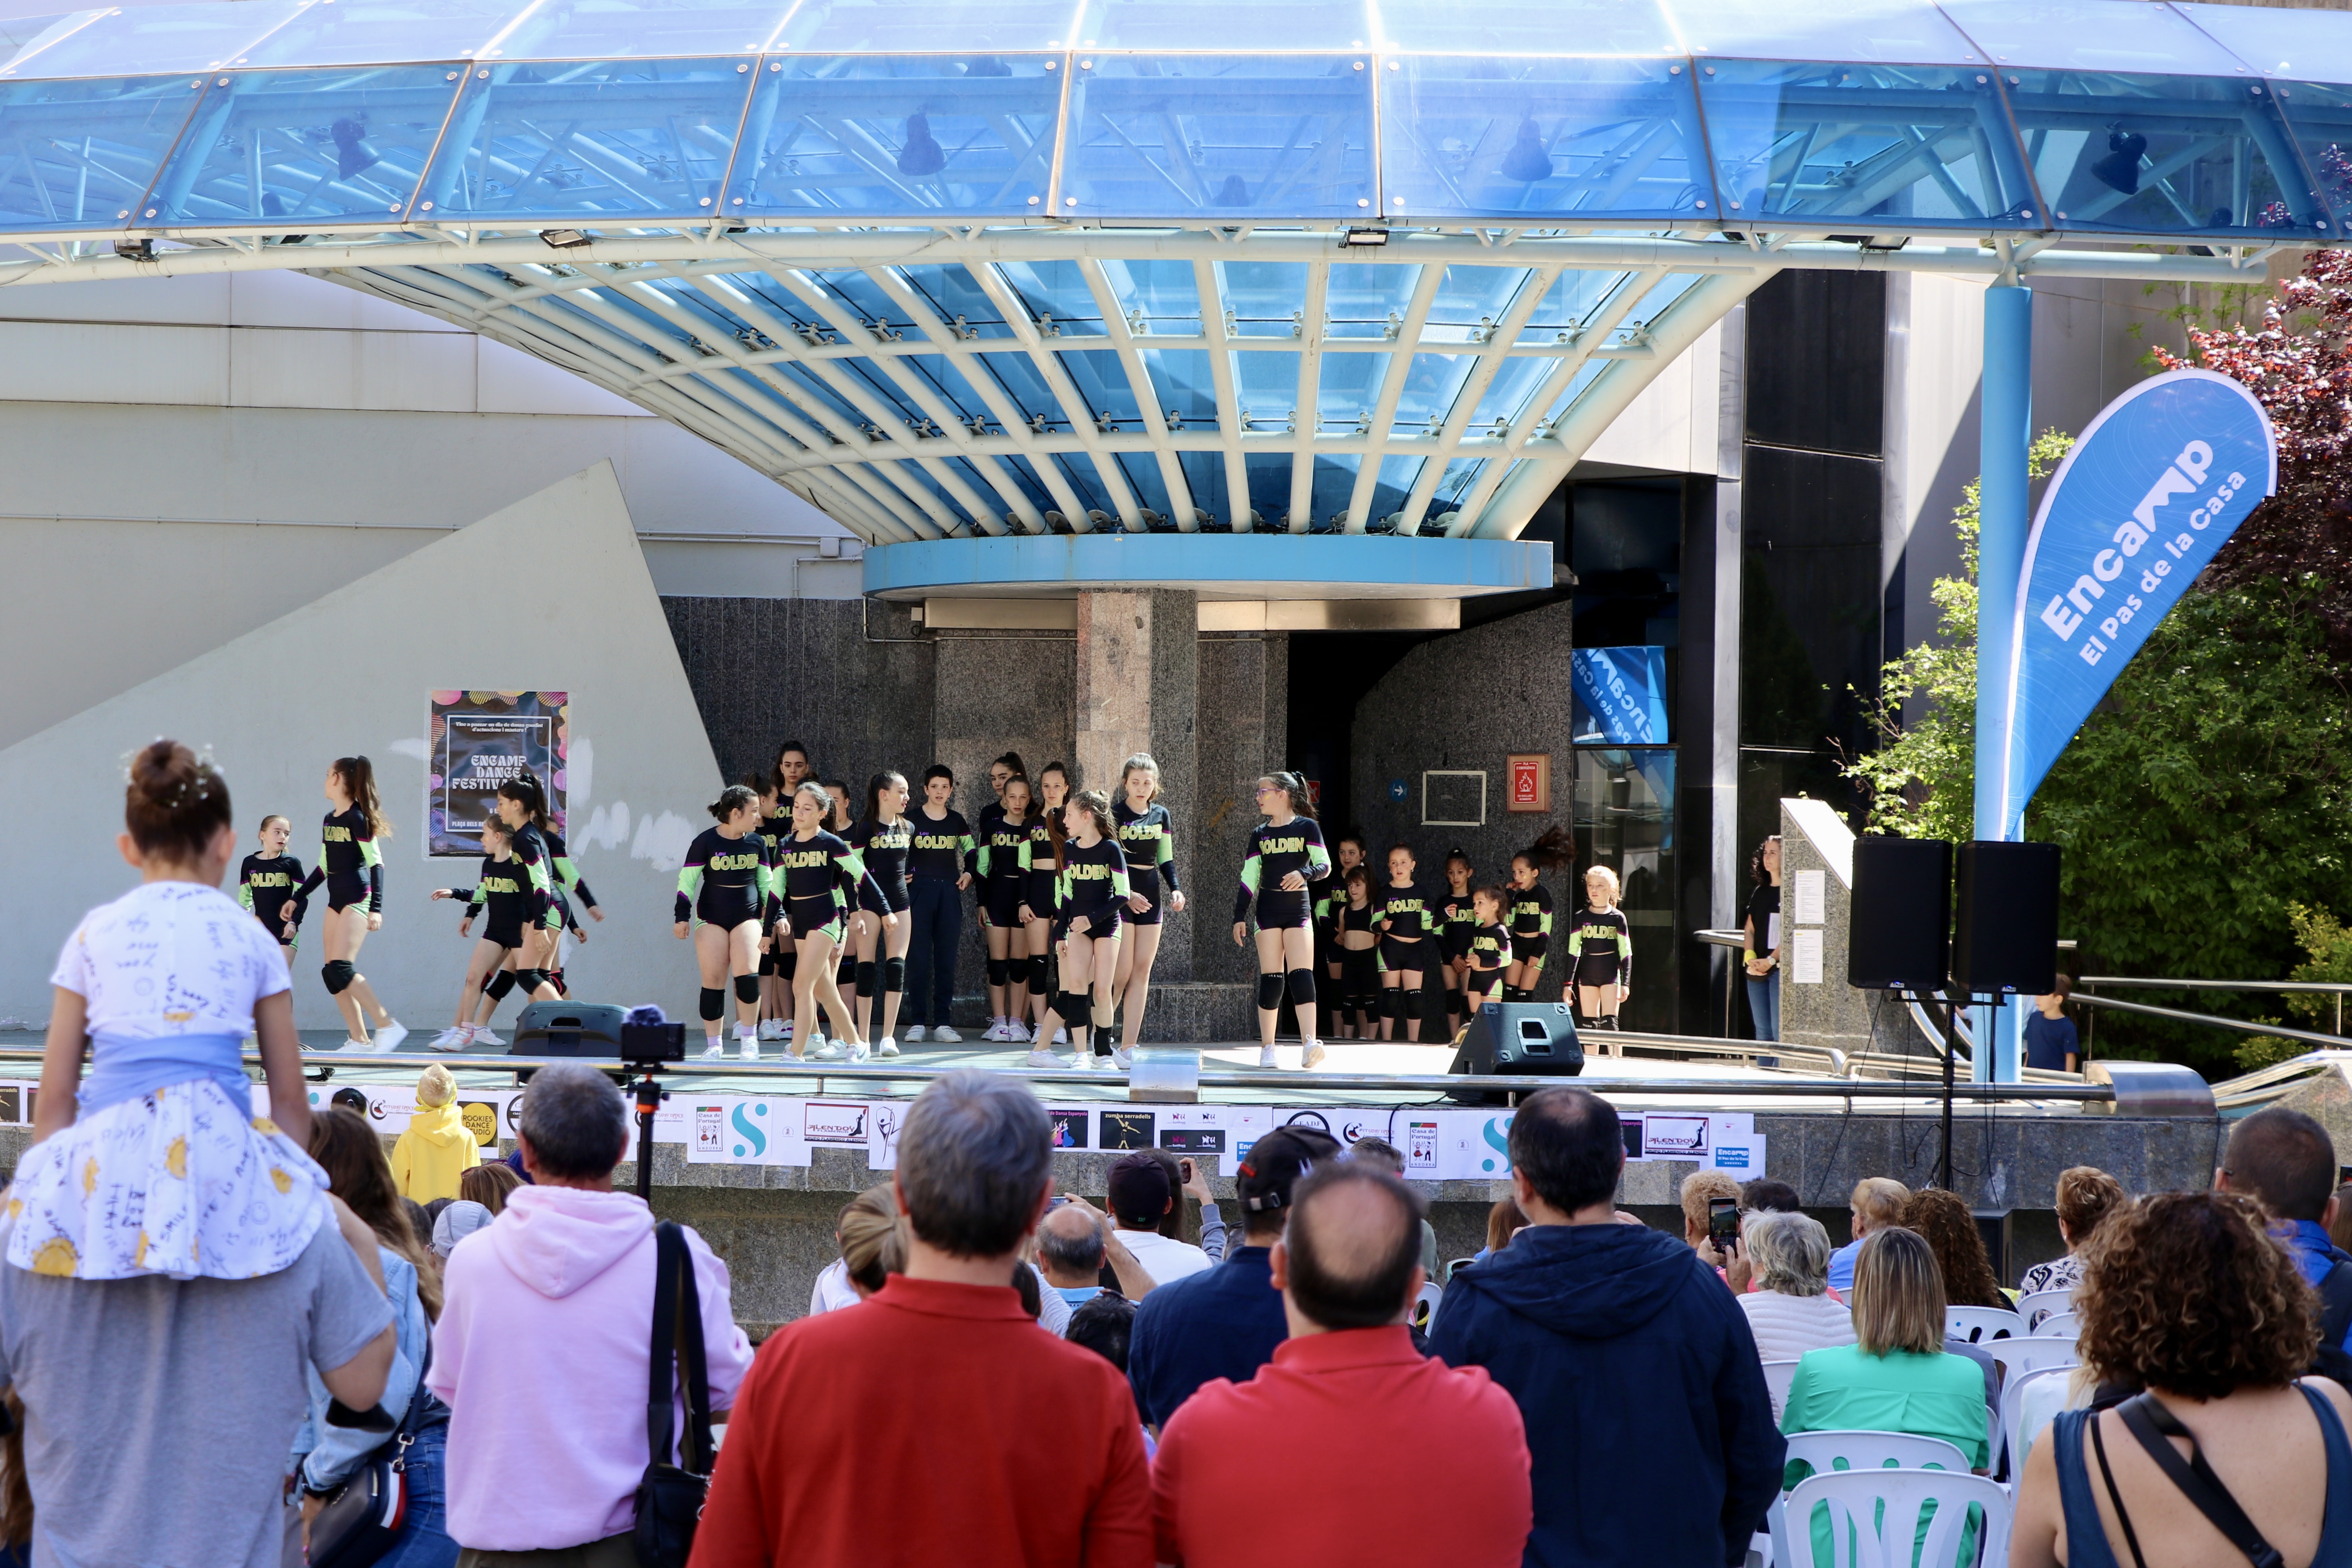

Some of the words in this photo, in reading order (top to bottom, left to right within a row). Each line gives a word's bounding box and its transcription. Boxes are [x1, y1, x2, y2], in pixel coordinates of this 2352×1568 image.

[2040, 440, 2213, 641] Encamp
[2079, 636, 2107, 666] El
[2100, 594, 2143, 640] Pas
[2140, 555, 2171, 594] de
[2165, 532, 2195, 562] la
[2190, 470, 2246, 530] Casa
[471, 755, 527, 766] ENCAMP
[476, 767, 521, 778] DANCE
[453, 778, 513, 790] FESTIV
[1030, 829, 1051, 842] GOL
[1119, 823, 1163, 840] GOLDE
[991, 834, 1020, 846] GOLD
[1070, 864, 1110, 880] OLDEN
